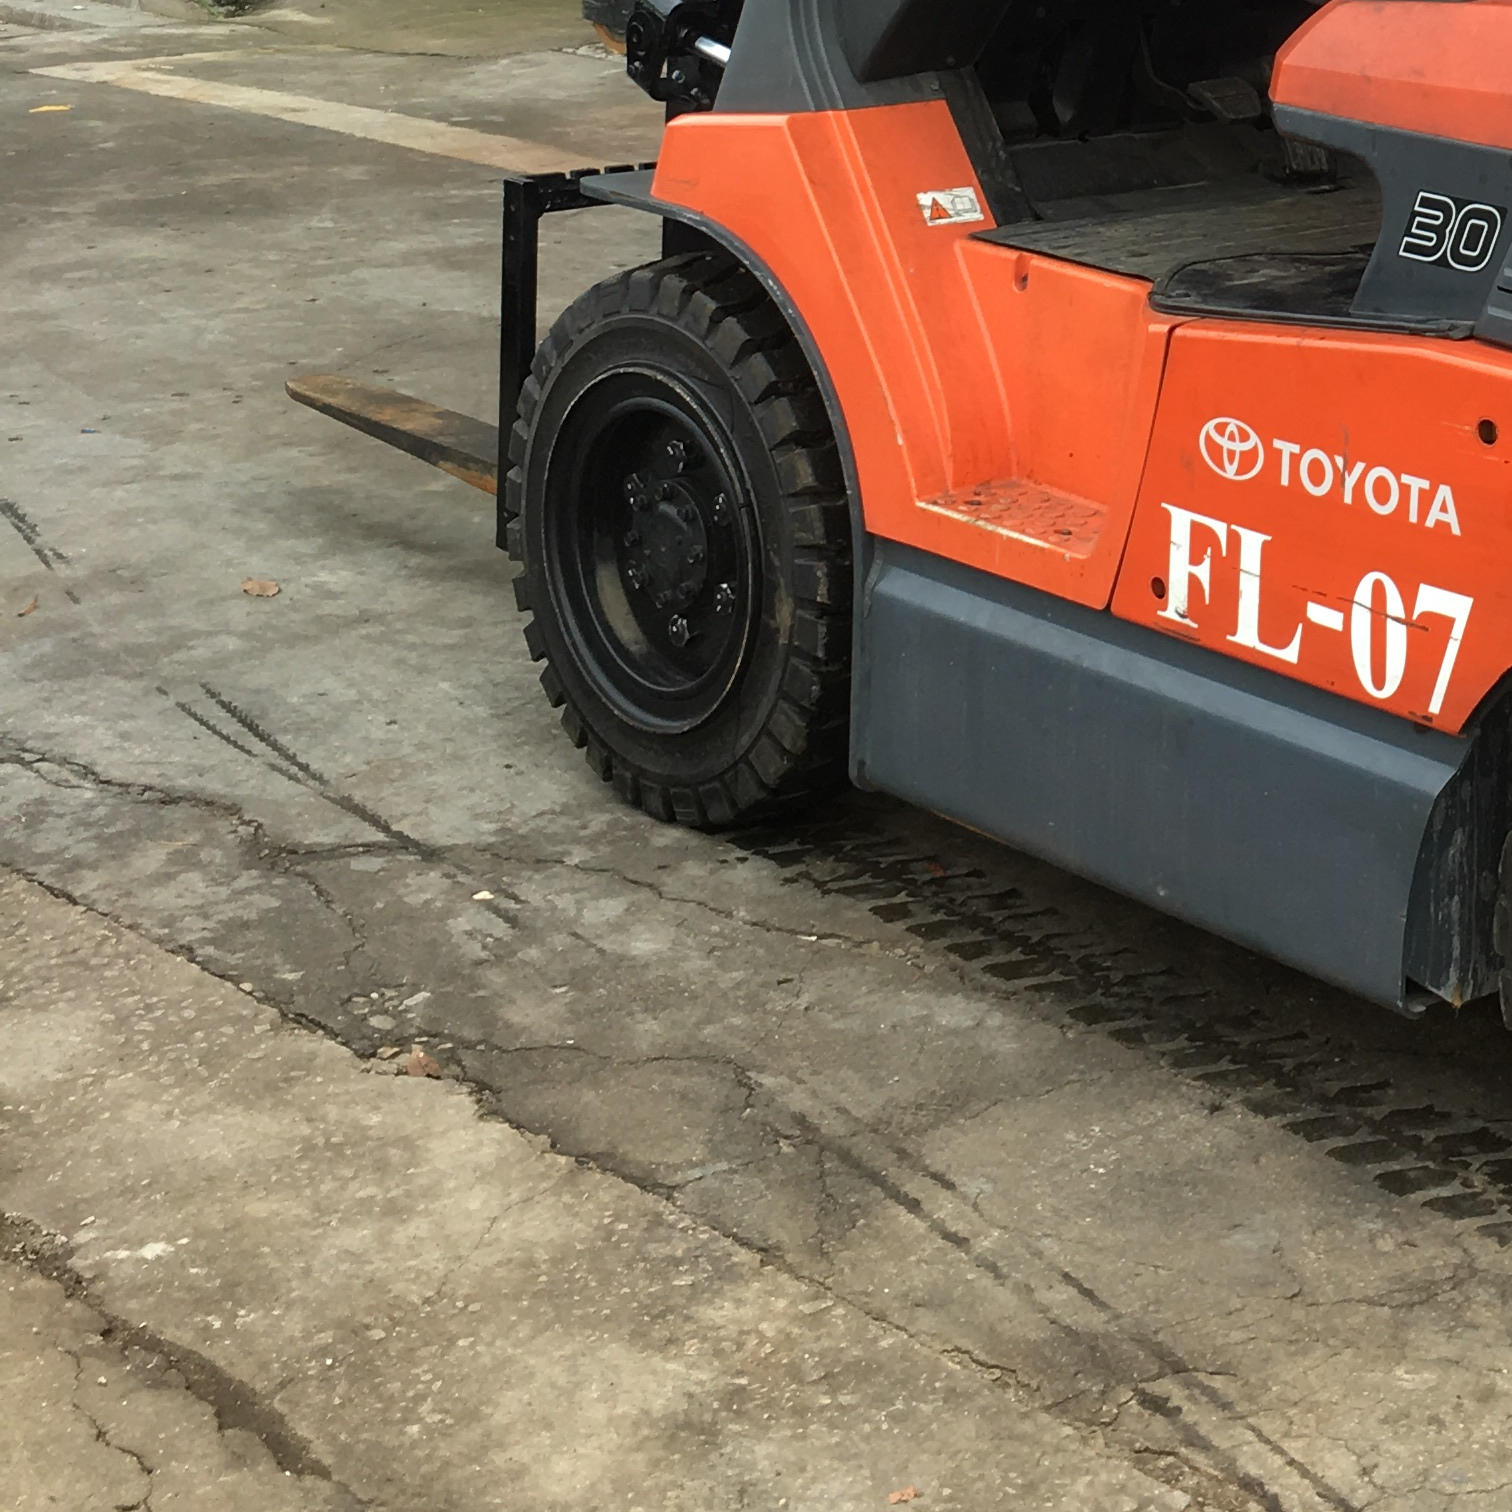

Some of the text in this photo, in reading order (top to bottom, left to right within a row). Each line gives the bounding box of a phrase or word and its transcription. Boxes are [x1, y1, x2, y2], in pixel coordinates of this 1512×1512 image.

[1399, 191, 1504, 272] 30
[1272, 438, 1462, 536] TOYOTA
[1157, 502, 1474, 716] FL-07
